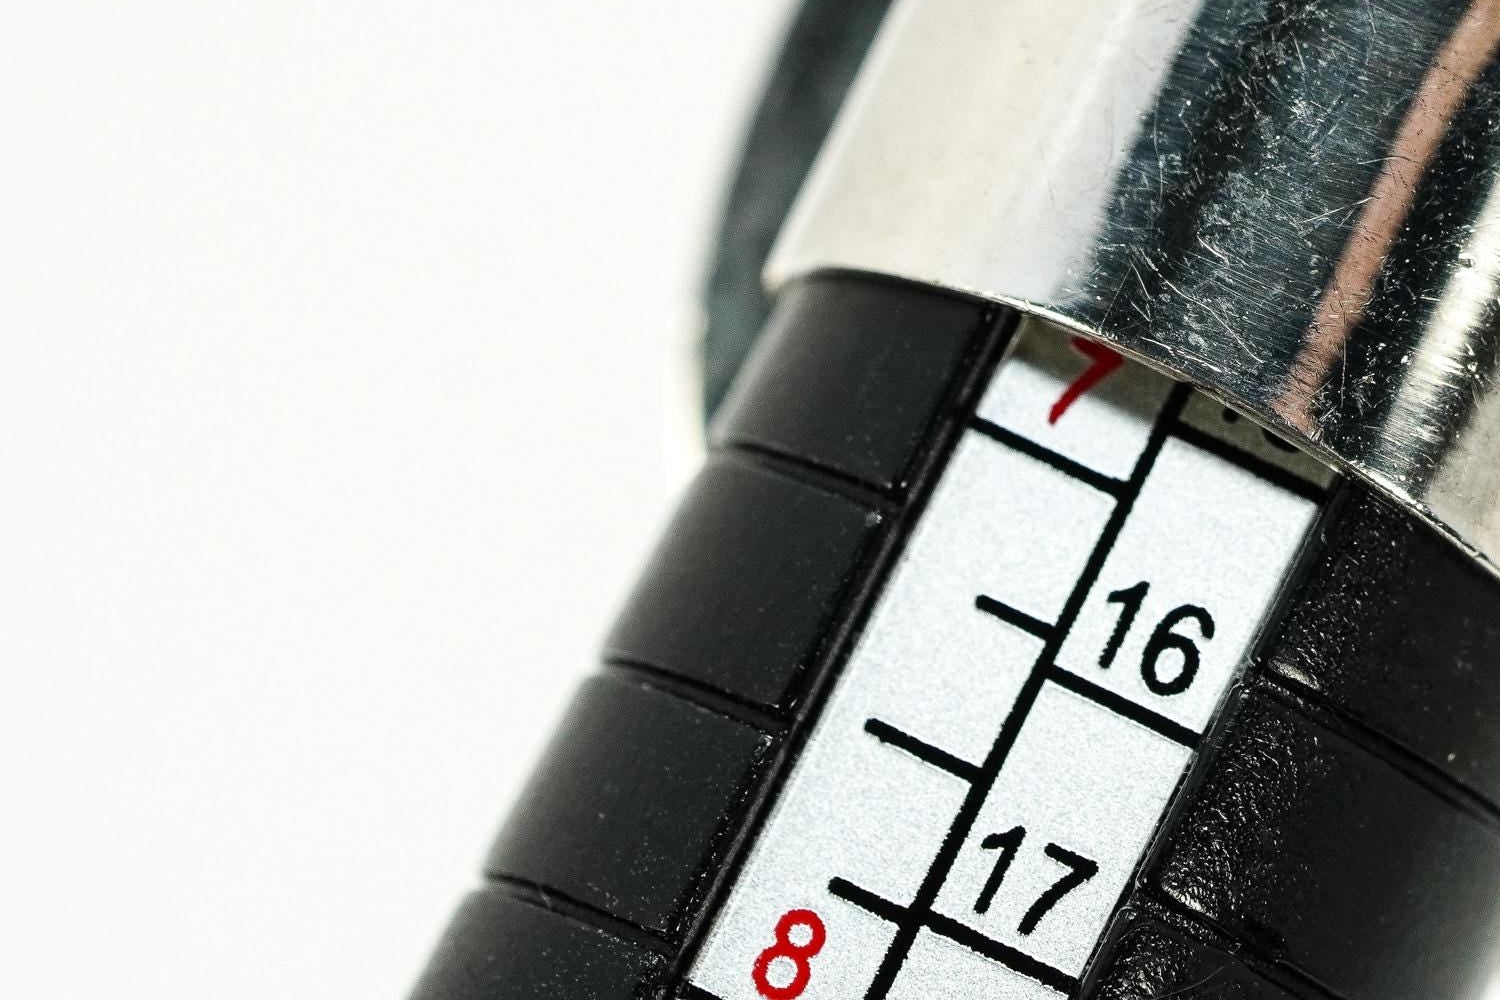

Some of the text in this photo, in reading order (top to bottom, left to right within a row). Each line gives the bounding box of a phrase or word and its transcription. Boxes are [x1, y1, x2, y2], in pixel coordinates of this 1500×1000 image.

[1047, 336, 1126, 425] 7
[1099, 581, 1215, 697] 16
[973, 825, 1100, 936] 17
[751, 909, 827, 1000] 8
